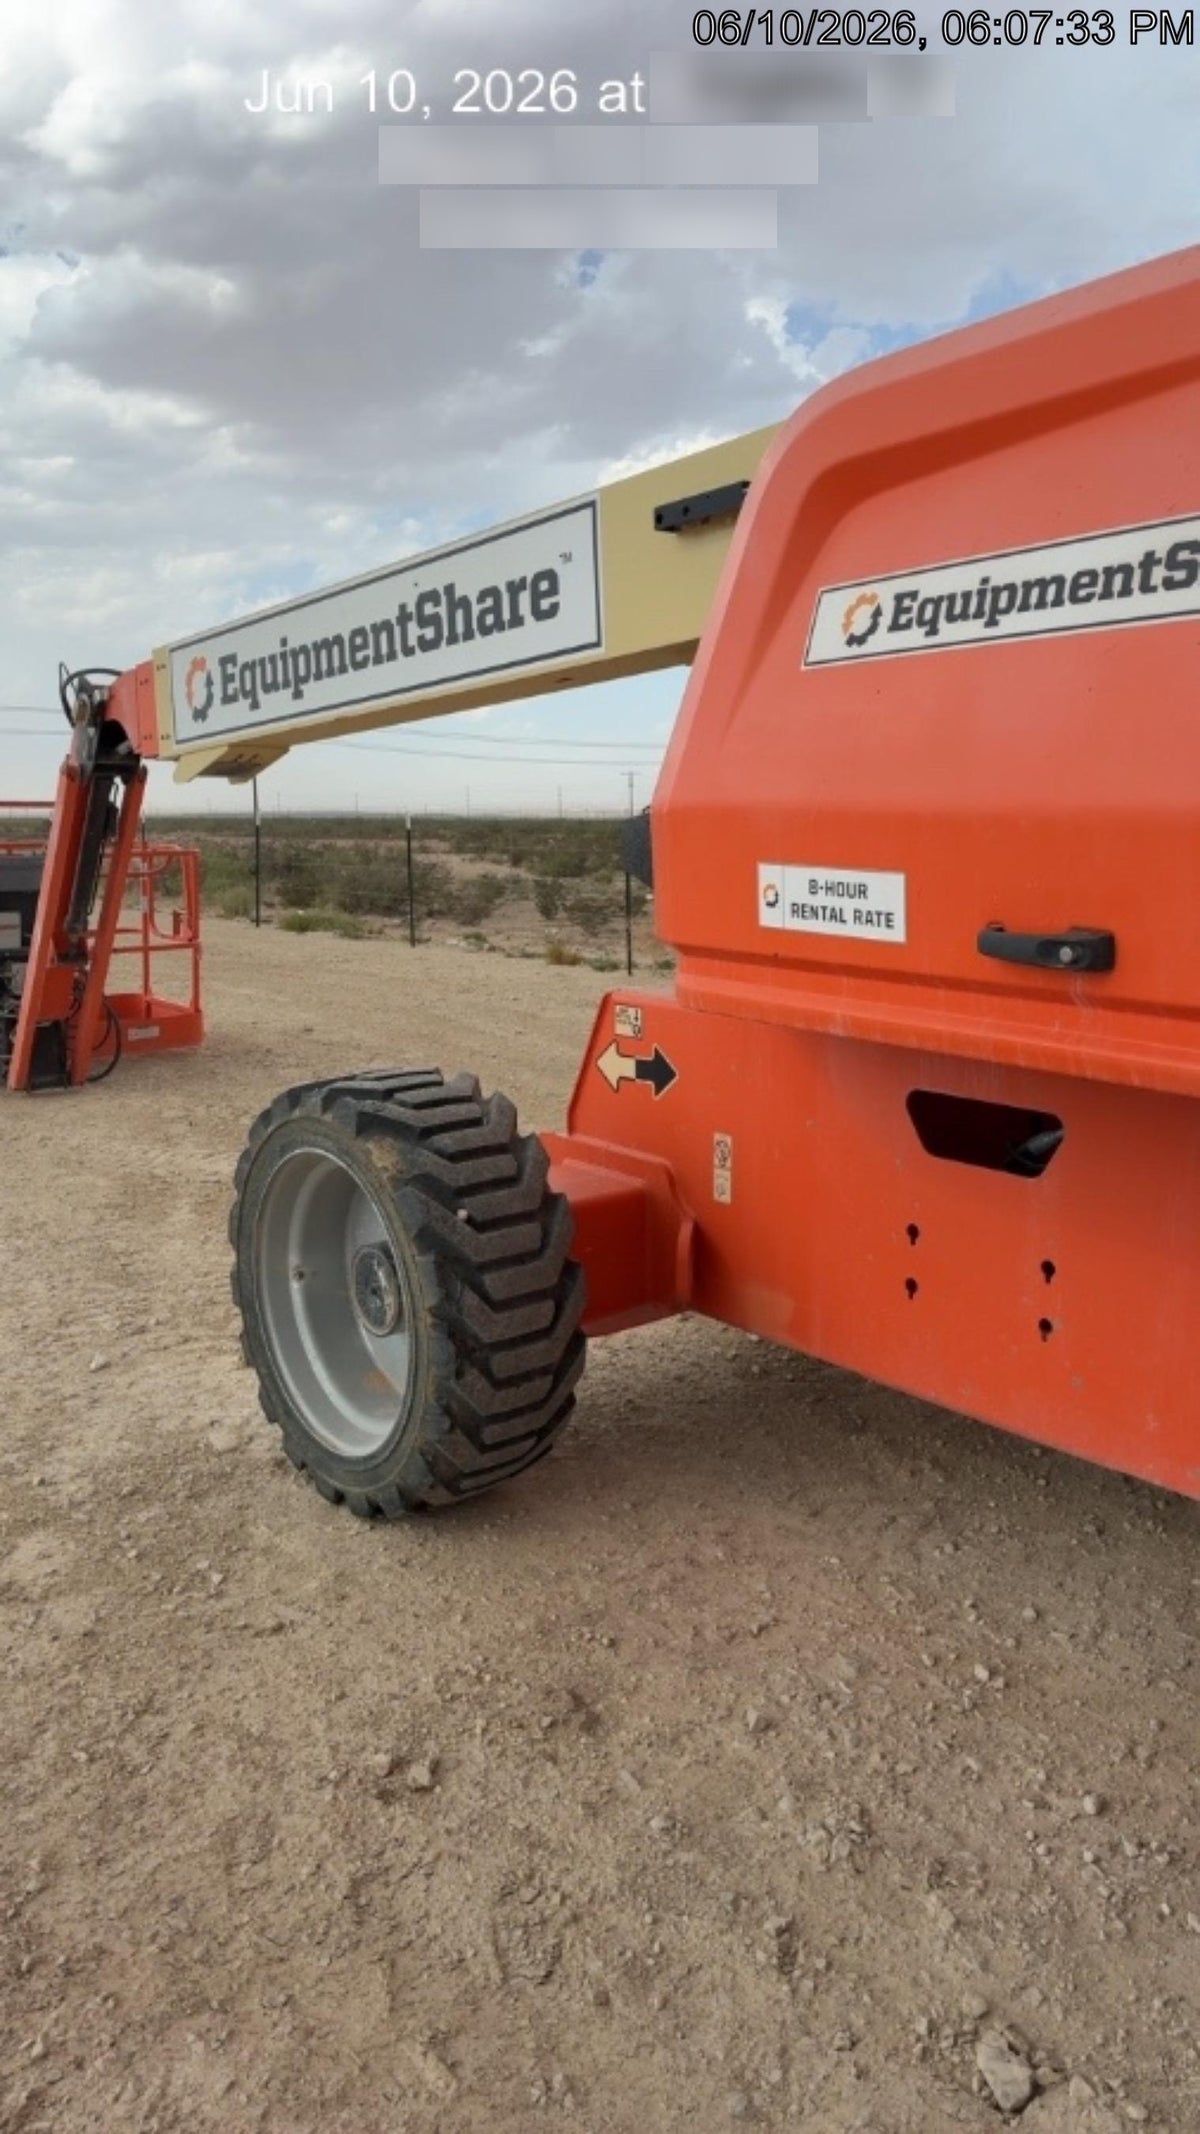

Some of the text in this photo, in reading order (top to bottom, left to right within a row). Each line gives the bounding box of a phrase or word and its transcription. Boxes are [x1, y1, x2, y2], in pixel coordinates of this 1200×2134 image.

[217, 567, 561, 711] EquipmentShare
[808, 878, 869, 900] 8-HOUR
[791, 902, 895, 929] RENTAL RATE
